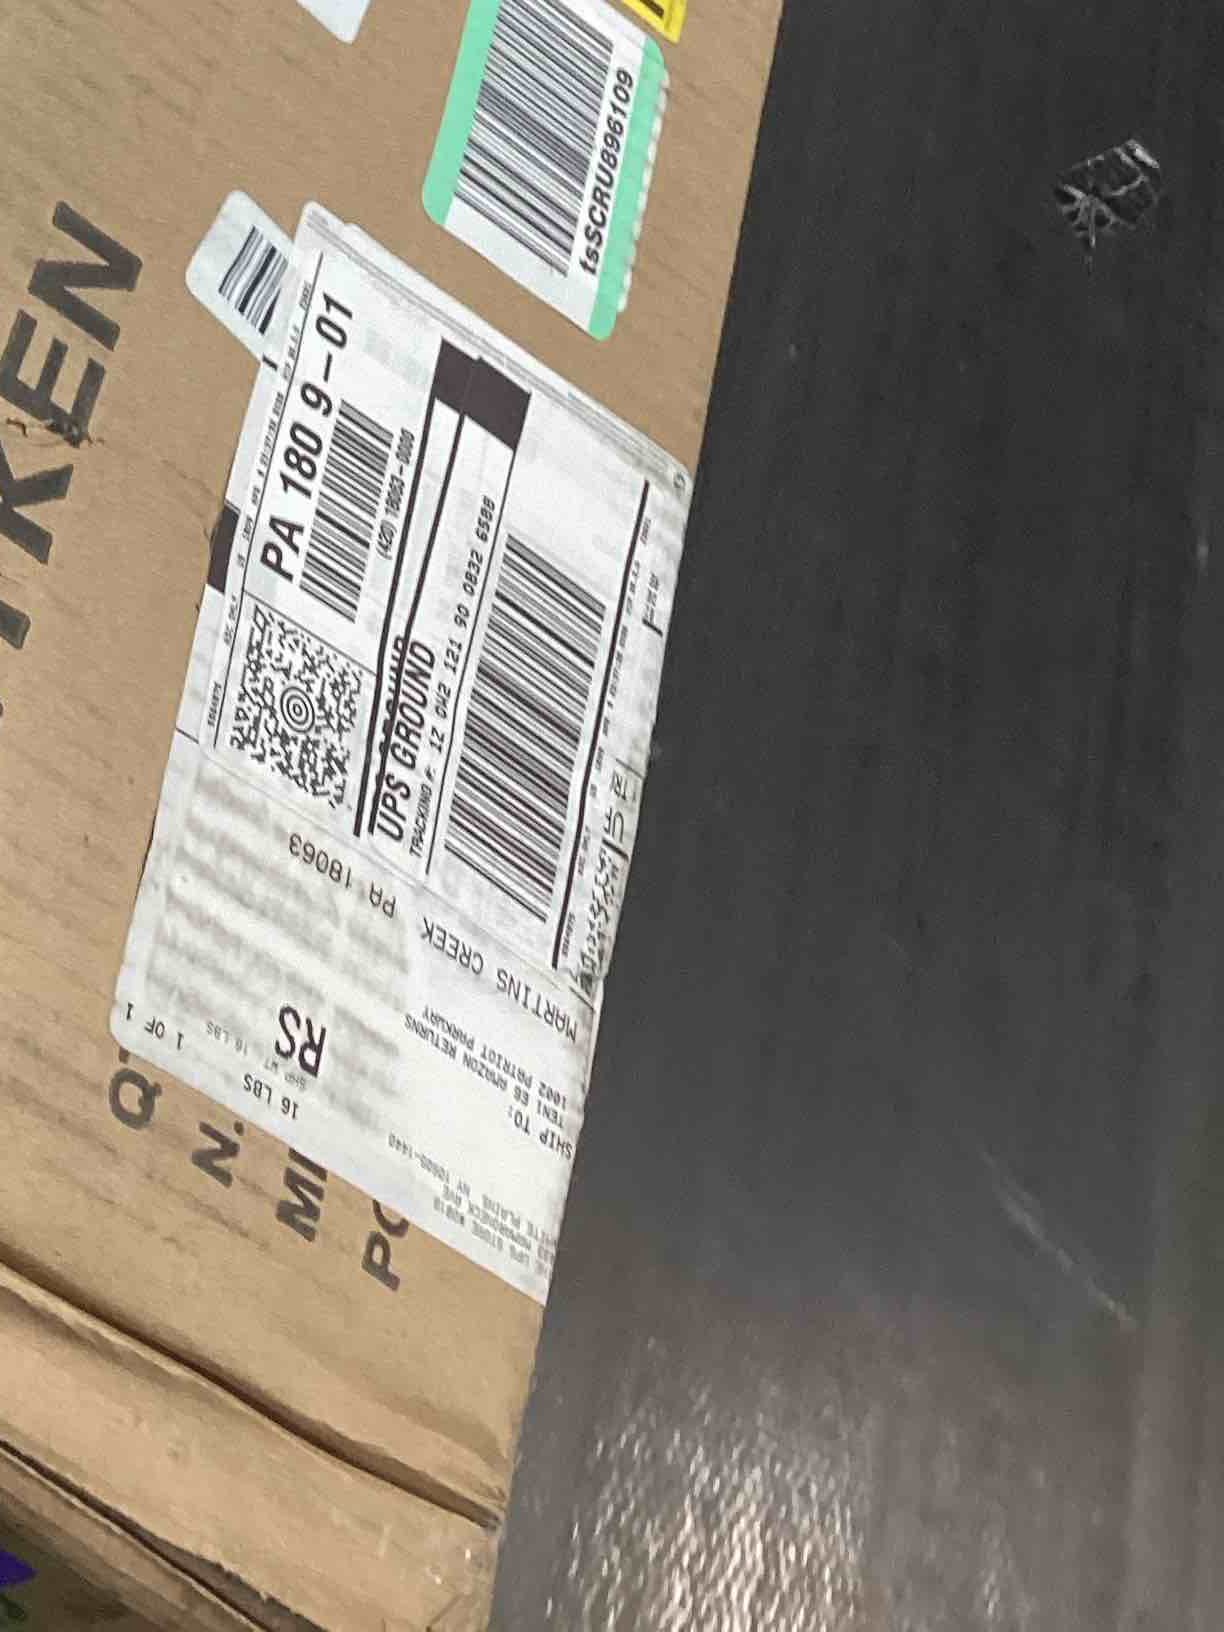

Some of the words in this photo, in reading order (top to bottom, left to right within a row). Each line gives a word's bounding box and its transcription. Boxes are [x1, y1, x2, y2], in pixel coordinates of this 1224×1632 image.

[579, 68, 635, 277] tsSCRU896109
[278, 420, 325, 500] 180
[259, 514, 305, 583] PA
[389, 639, 437, 771] GROUND
[408, 783, 433, 859] TRACKING
[430, 728, 446, 754] 1Z
[443, 638, 463, 675] 121
[453, 603, 471, 629] 90
[375, 773, 412, 844] UPS
[287, 832, 353, 890] 18063
[368, 882, 398, 920] PA
[419, 915, 484, 976] CREEK
[125, 1001, 134, 1022] 1
[421, 1003, 474, 1046] PARKWAY
[495, 967, 579, 1042] MARTINS
[144, 1015, 166, 1041] OF
[175, 1031, 185, 1051] 1
[276, 1004, 327, 1079] RS
[403, 1011, 461, 1059] RETURNS
[460, 1050, 510, 1091] AMAZON
[475, 1043, 534, 1087] PATRIOT
[243, 1073, 274, 1106] LBS
[280, 1096, 300, 1121] 16
[506, 1108, 532, 1135] TO:
[538, 1130, 573, 1161] SHIP
